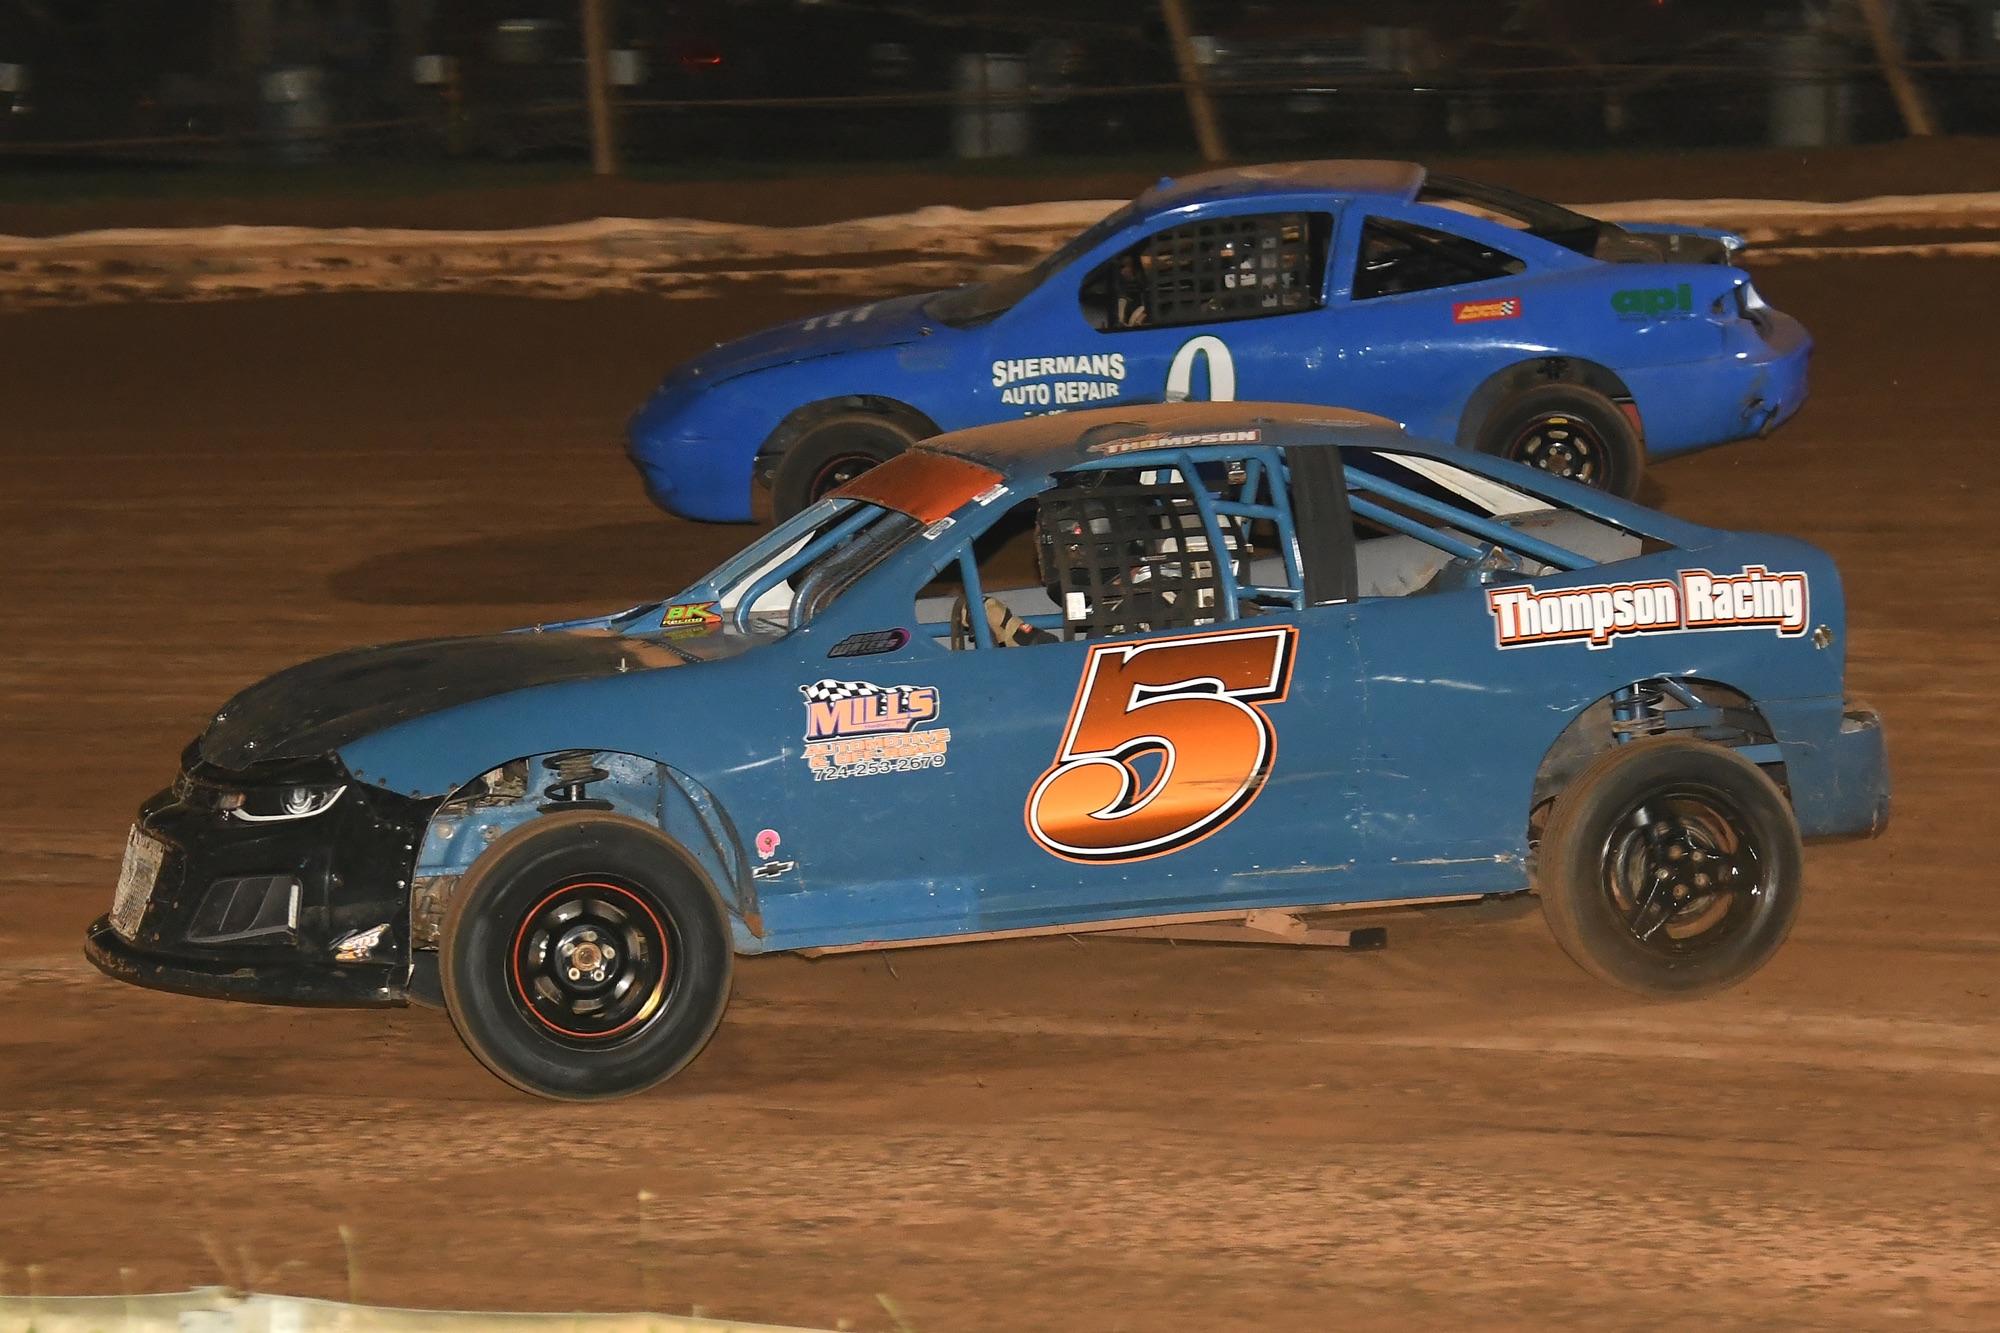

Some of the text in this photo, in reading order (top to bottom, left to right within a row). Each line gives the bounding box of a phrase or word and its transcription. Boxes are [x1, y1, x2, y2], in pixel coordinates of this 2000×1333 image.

[992, 353, 1125, 387] SHERMANS
[1001, 382, 1119, 405] AUTO REPAIR
[1106, 430, 1259, 454] THOMPSON
[664, 602, 720, 621] BK
[1490, 567, 1806, 645] Thompson Racing
[809, 689, 935, 737] MILLS
[804, 728, 950, 757] AUTOMOTIVE
[1025, 625, 1299, 865] 5
[814, 755, 945, 781] 724-253-2679
